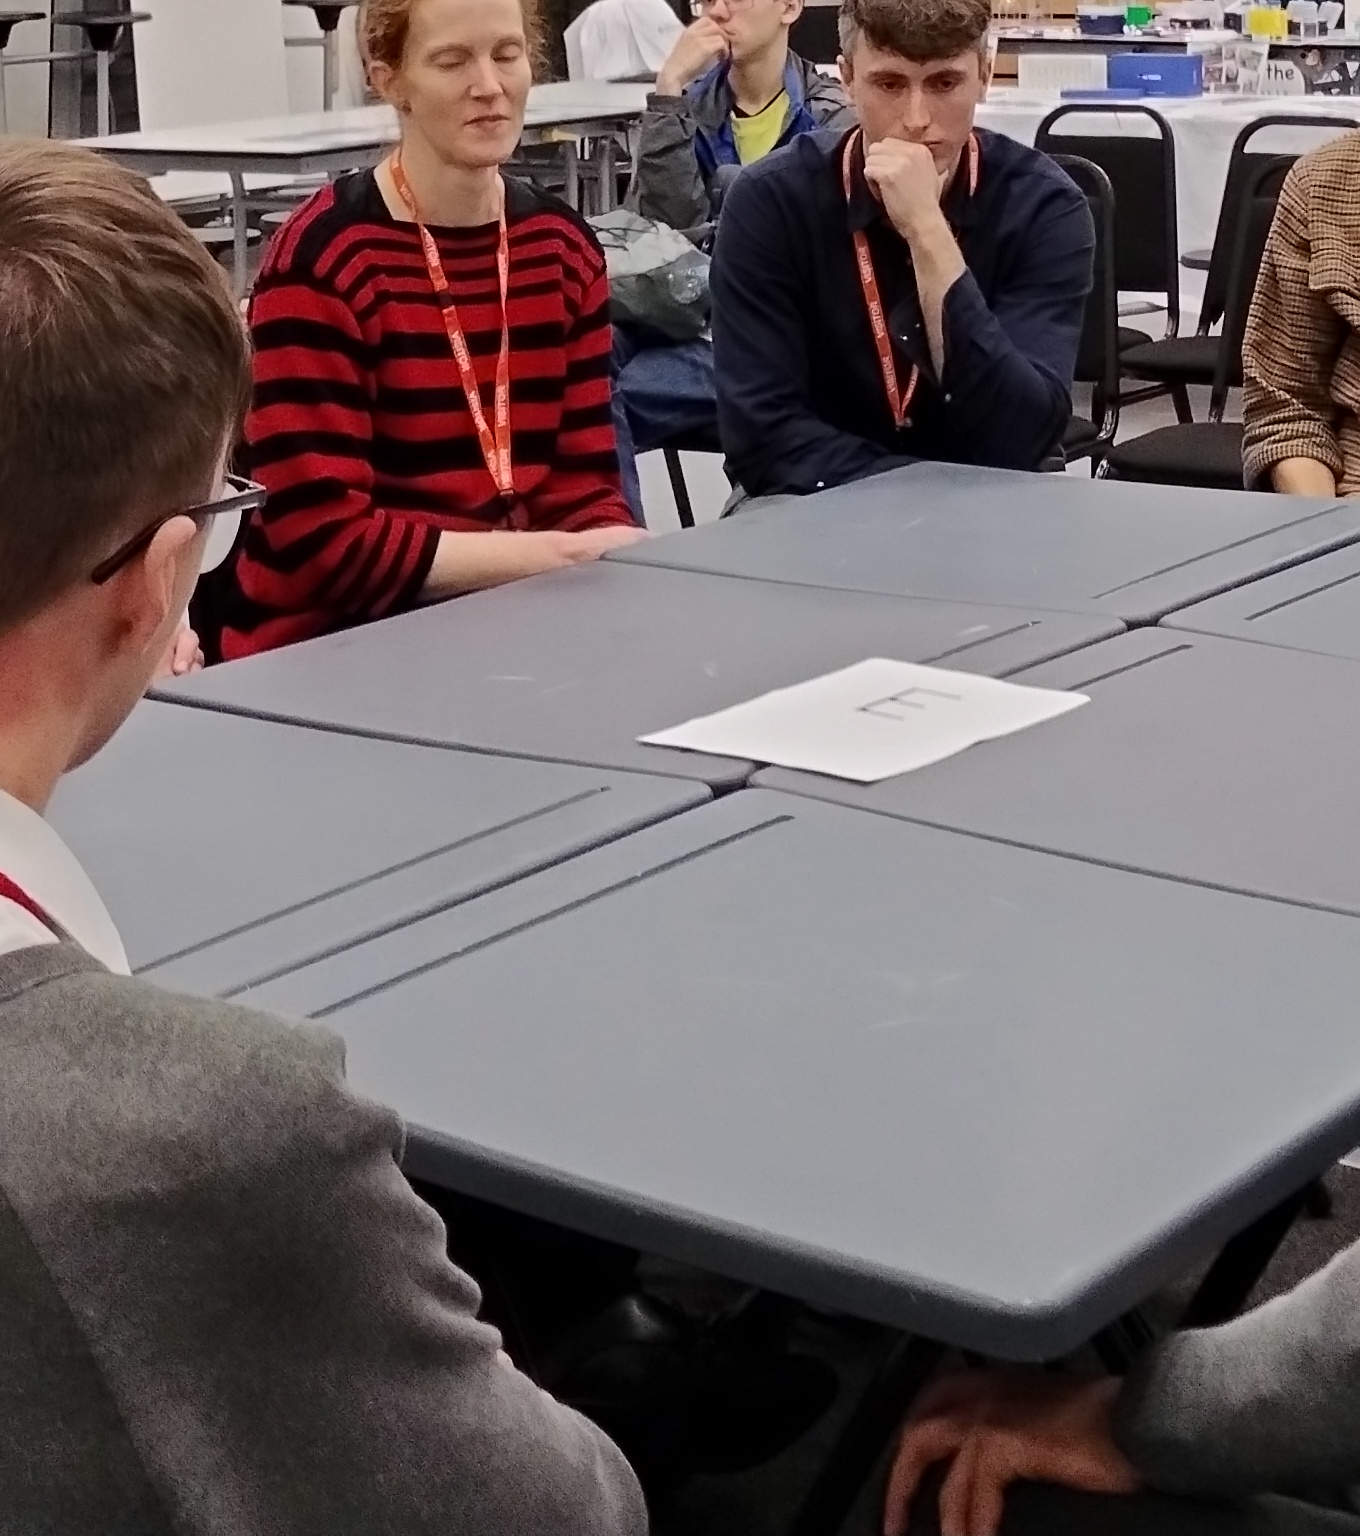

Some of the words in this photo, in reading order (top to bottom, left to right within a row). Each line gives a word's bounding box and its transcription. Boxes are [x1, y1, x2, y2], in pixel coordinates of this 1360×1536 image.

[1266, 64, 1295, 81] the
[869, 300, 885, 339] VISITOR
[854, 685, 963, 722] E
